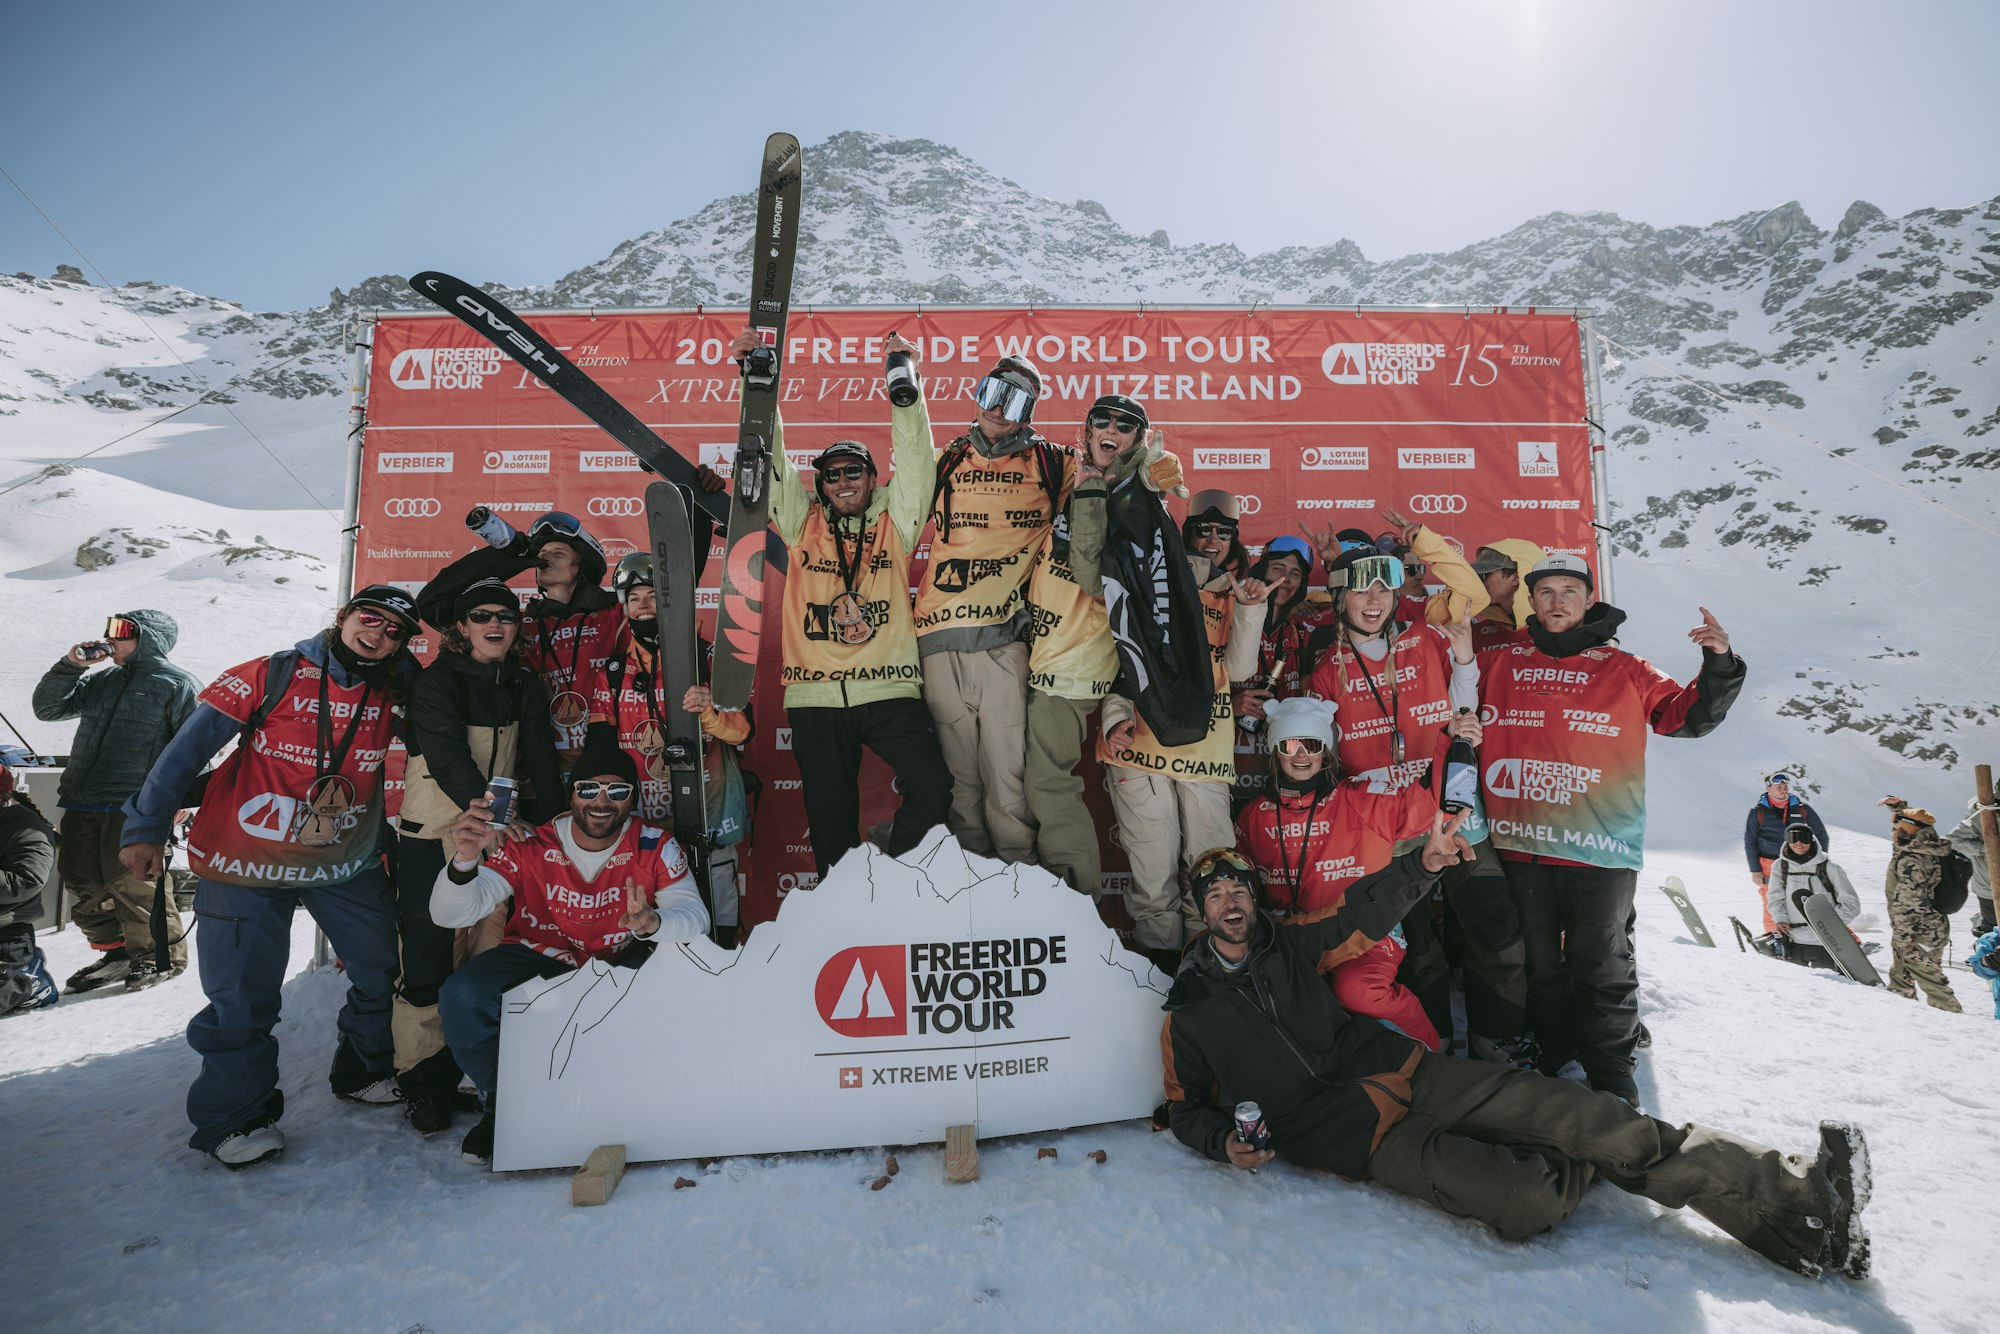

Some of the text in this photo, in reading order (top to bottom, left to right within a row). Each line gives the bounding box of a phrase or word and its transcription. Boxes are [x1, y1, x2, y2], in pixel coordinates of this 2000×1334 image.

[757, 304, 781, 313] SUISSE
[456, 295, 560, 375] HEAD
[581, 345, 599, 355] TH
[788, 336, 980, 364] FREEIDE
[994, 335, 1147, 363] WORLD
[1161, 335, 1275, 363] TOUR
[1366, 342, 1446, 358] FREERIDE
[1512, 344, 1530, 354] TH
[433, 360, 501, 376] WORLD
[576, 355, 630, 367] EDITION
[1367, 356, 1436, 371] WORLD
[1449, 343, 1504, 387] 15
[1511, 355, 1562, 367] EDITION
[433, 375, 483, 390] TOUR
[1368, 370, 1420, 385] TOUR
[646, 377, 805, 403] XTREE
[1040, 373, 1302, 402] SWITZERLAND
[584, 455, 639, 469] VERBIE
[1198, 452, 1263, 468] VERBIER
[1322, 458, 1367, 466] ROMANDE
[1330, 450, 1367, 458] LOTERIE
[1402, 452, 1467, 468] VERBIER
[383, 456, 446, 470] VERBIER
[1521, 463, 1556, 475] Valais
[955, 469, 1024, 485] VERBIER
[513, 502, 554, 511] TIRES
[1296, 500, 1376, 510] TOYO TIRES
[1502, 500, 1580, 510] TOYO TIRES
[1004, 509, 1042, 521] TOYO
[950, 521, 989, 530] OMANDE
[1542, 546, 1587, 555] Diamond
[658, 540, 671, 609] HEAD
[1512, 667, 1590, 686] VERBIER
[1542, 684, 1584, 695] ENERGY
[1408, 699, 1448, 717] TOYO
[1505, 708, 1546, 719] LOTERIE
[1561, 708, 1611, 723] TOYO
[1351, 716, 1396, 731] LOTERIE
[1497, 717, 1545, 728] ROMANDE
[1567, 720, 1621, 738] TIRES
[1522, 759, 1602, 785] FREERIDE
[774, 780, 803, 790] TOY
[1522, 772, 1588, 794] WORLD
[1521, 784, 1572, 806] TOUR
[1563, 828, 1631, 857] MAWN
[208, 850, 329, 882] MANUELA
[1314, 855, 1356, 872] TOYO
[1322, 866, 1366, 882] TIRES
[545, 883, 621, 910] VERBIER
[1817, 920, 1842, 951] HEAD
[910, 935, 1067, 973] FREERIDE
[911, 967, 1047, 1004] WORLD
[911, 1000, 1016, 1035] TOUR
[872, 1056, 1049, 1085] XTREME VERBIER
